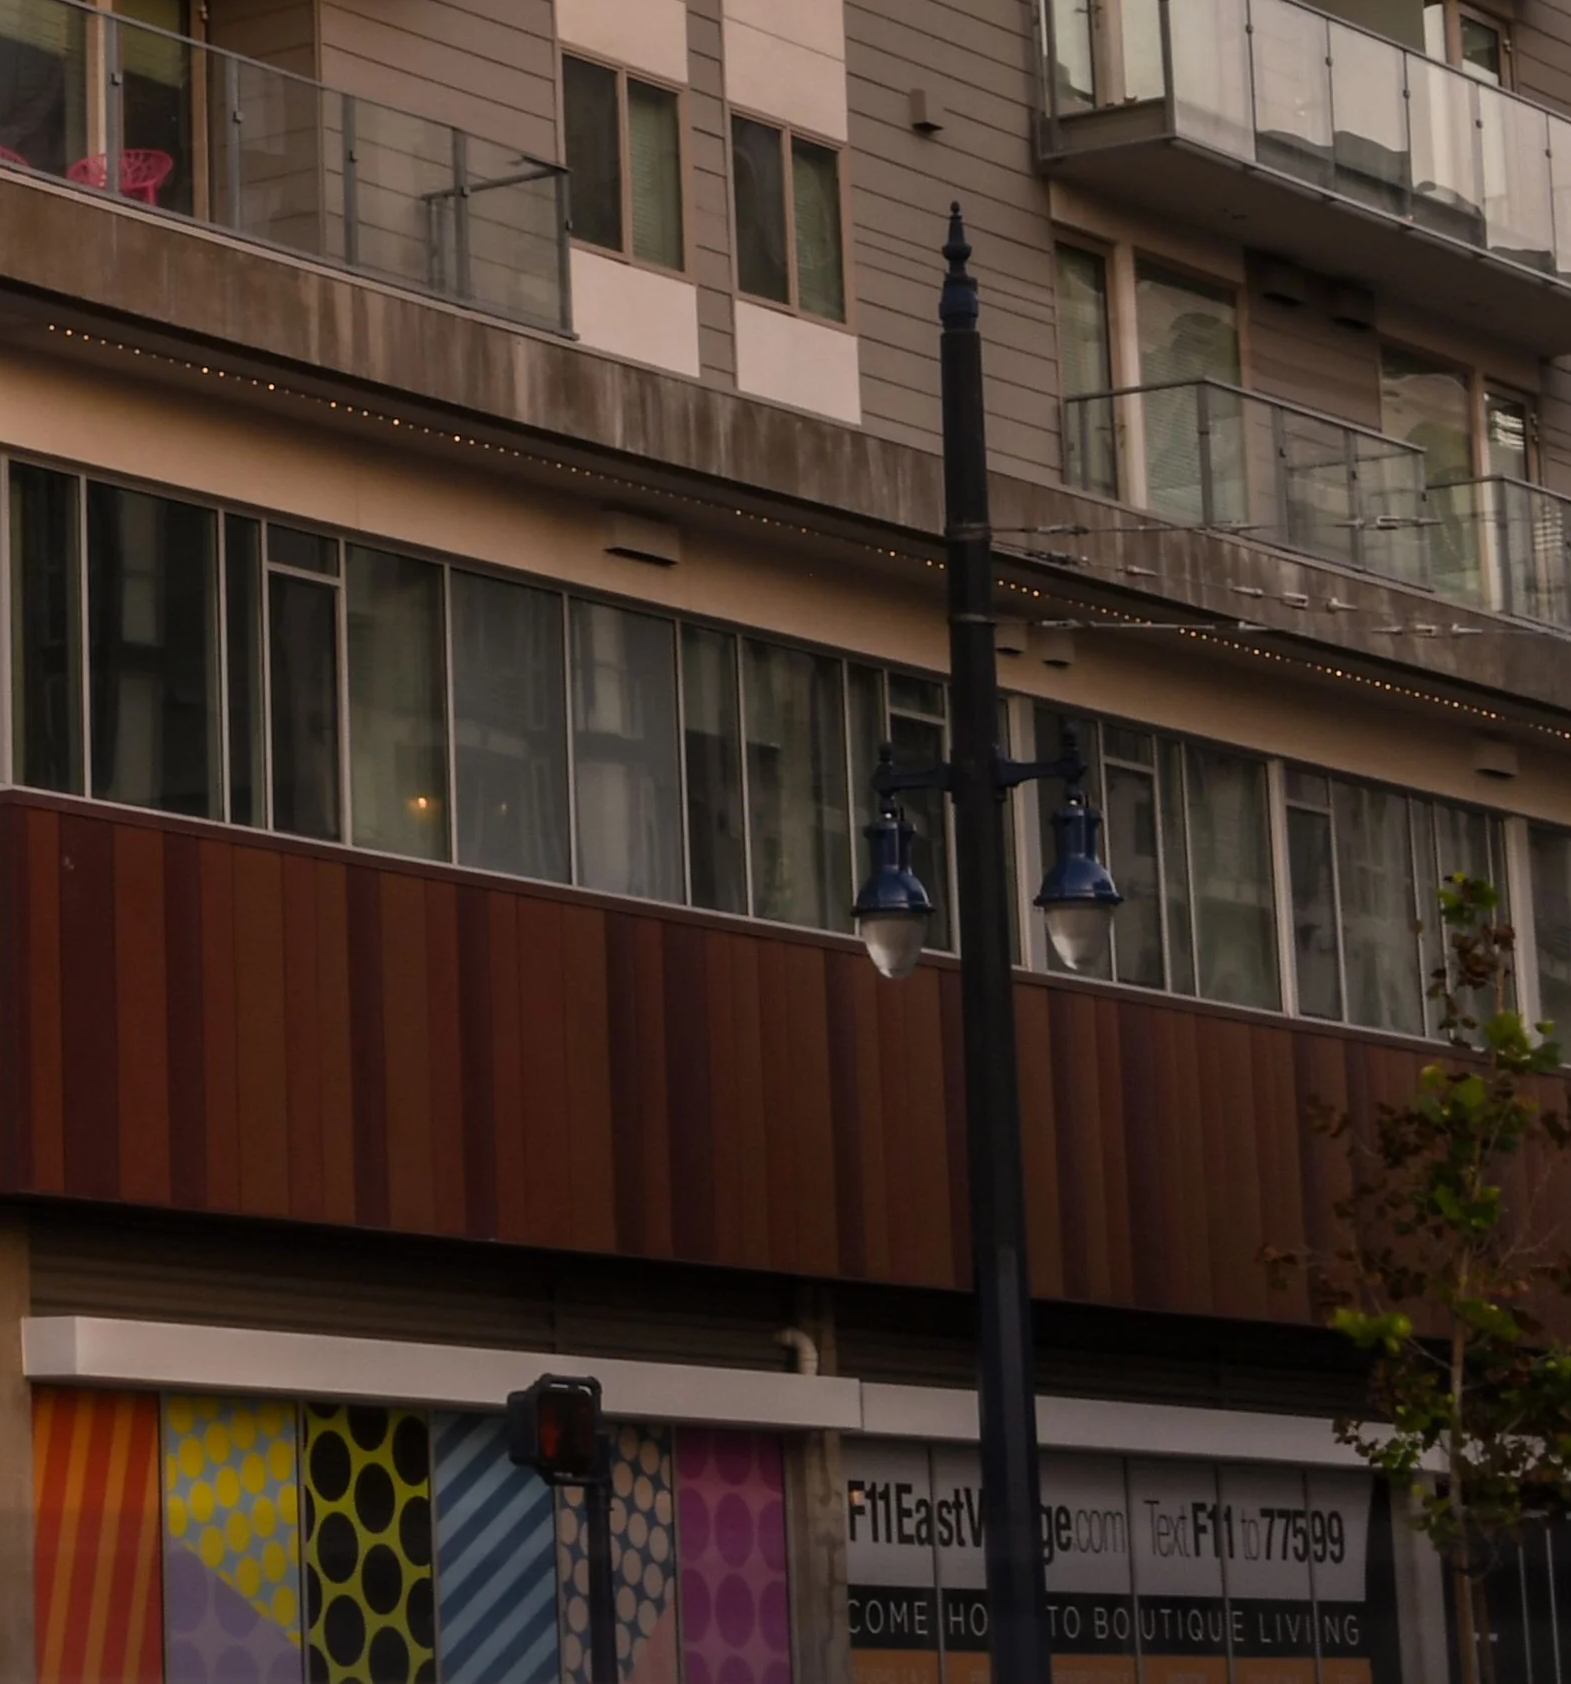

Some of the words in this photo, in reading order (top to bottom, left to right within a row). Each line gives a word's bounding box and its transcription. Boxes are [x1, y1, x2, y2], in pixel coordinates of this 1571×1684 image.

[847, 1479, 1127, 1566] F11EastVge.com
[1143, 1499, 1191, 1559] Text
[1191, 1502, 1235, 1560] F11
[1241, 1508, 1261, 1562] to
[1260, 1507, 1346, 1564] 77599
[847, 1599, 929, 1636] COME
[948, 1602, 989, 1638] HO
[1046, 1604, 1082, 1639] TO
[1093, 1606, 1246, 1643] BOUTIQUE
[1257, 1613, 1360, 1646] LIVING
